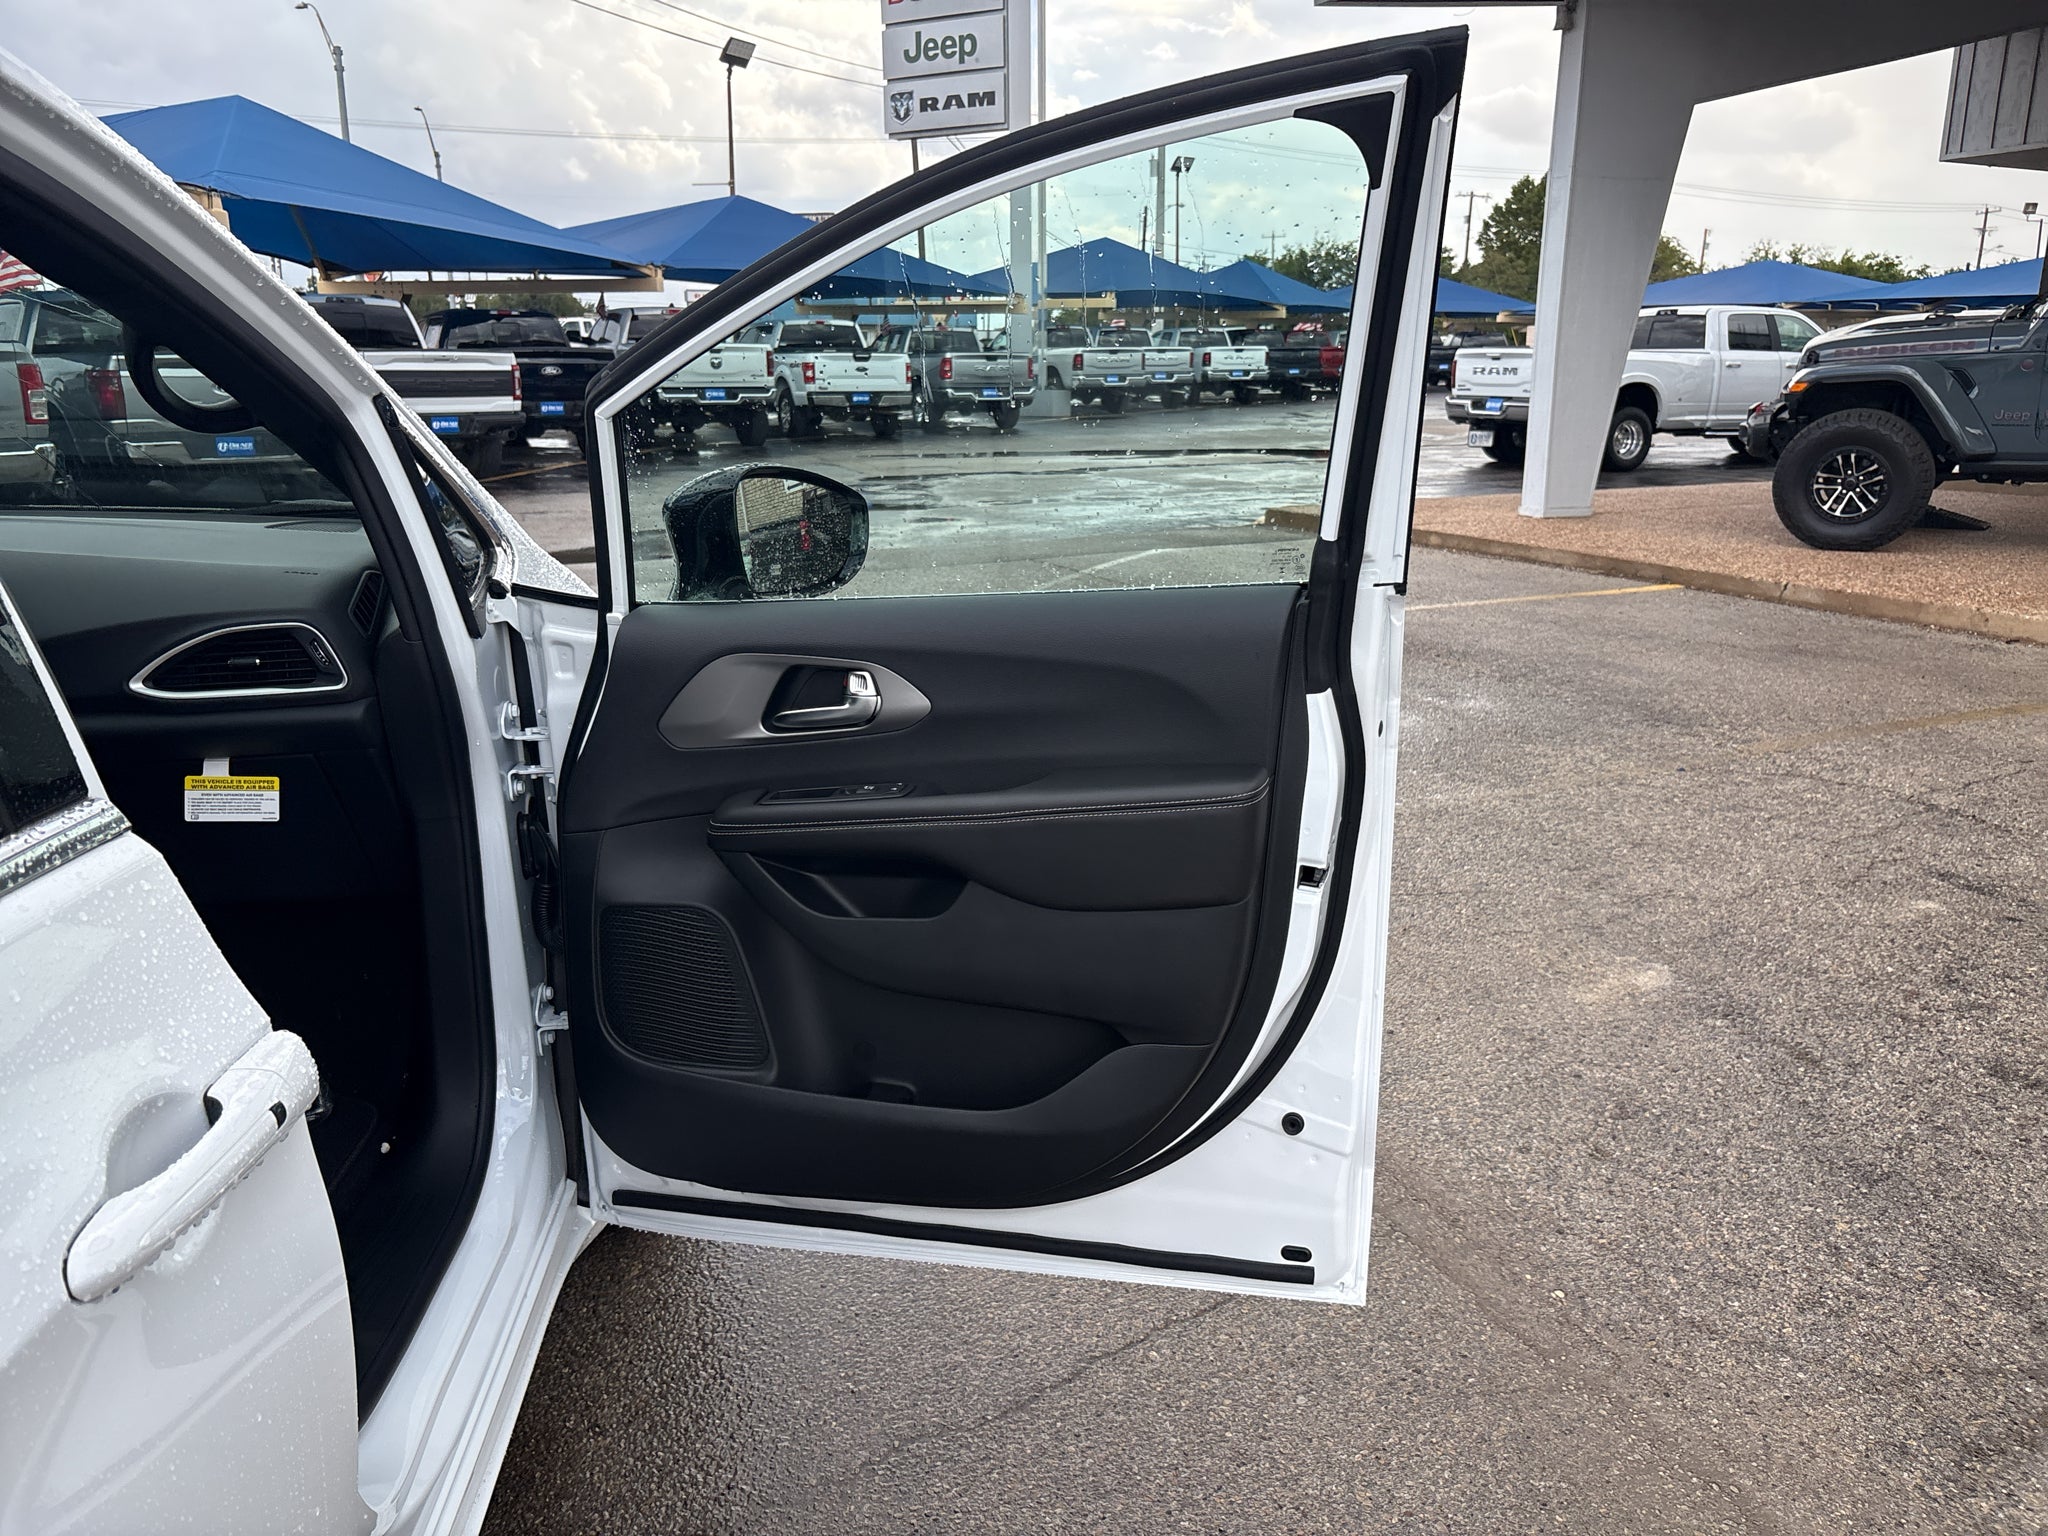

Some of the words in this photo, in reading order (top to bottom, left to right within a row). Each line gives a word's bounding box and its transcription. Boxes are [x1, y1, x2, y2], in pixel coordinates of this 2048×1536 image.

[903, 31, 978, 65] Jeep
[919, 91, 996, 113] RAM
[1834, 340, 1977, 358] RUBICON
[1472, 367, 1519, 376] RAM
[1994, 409, 2032, 422] Jeep
